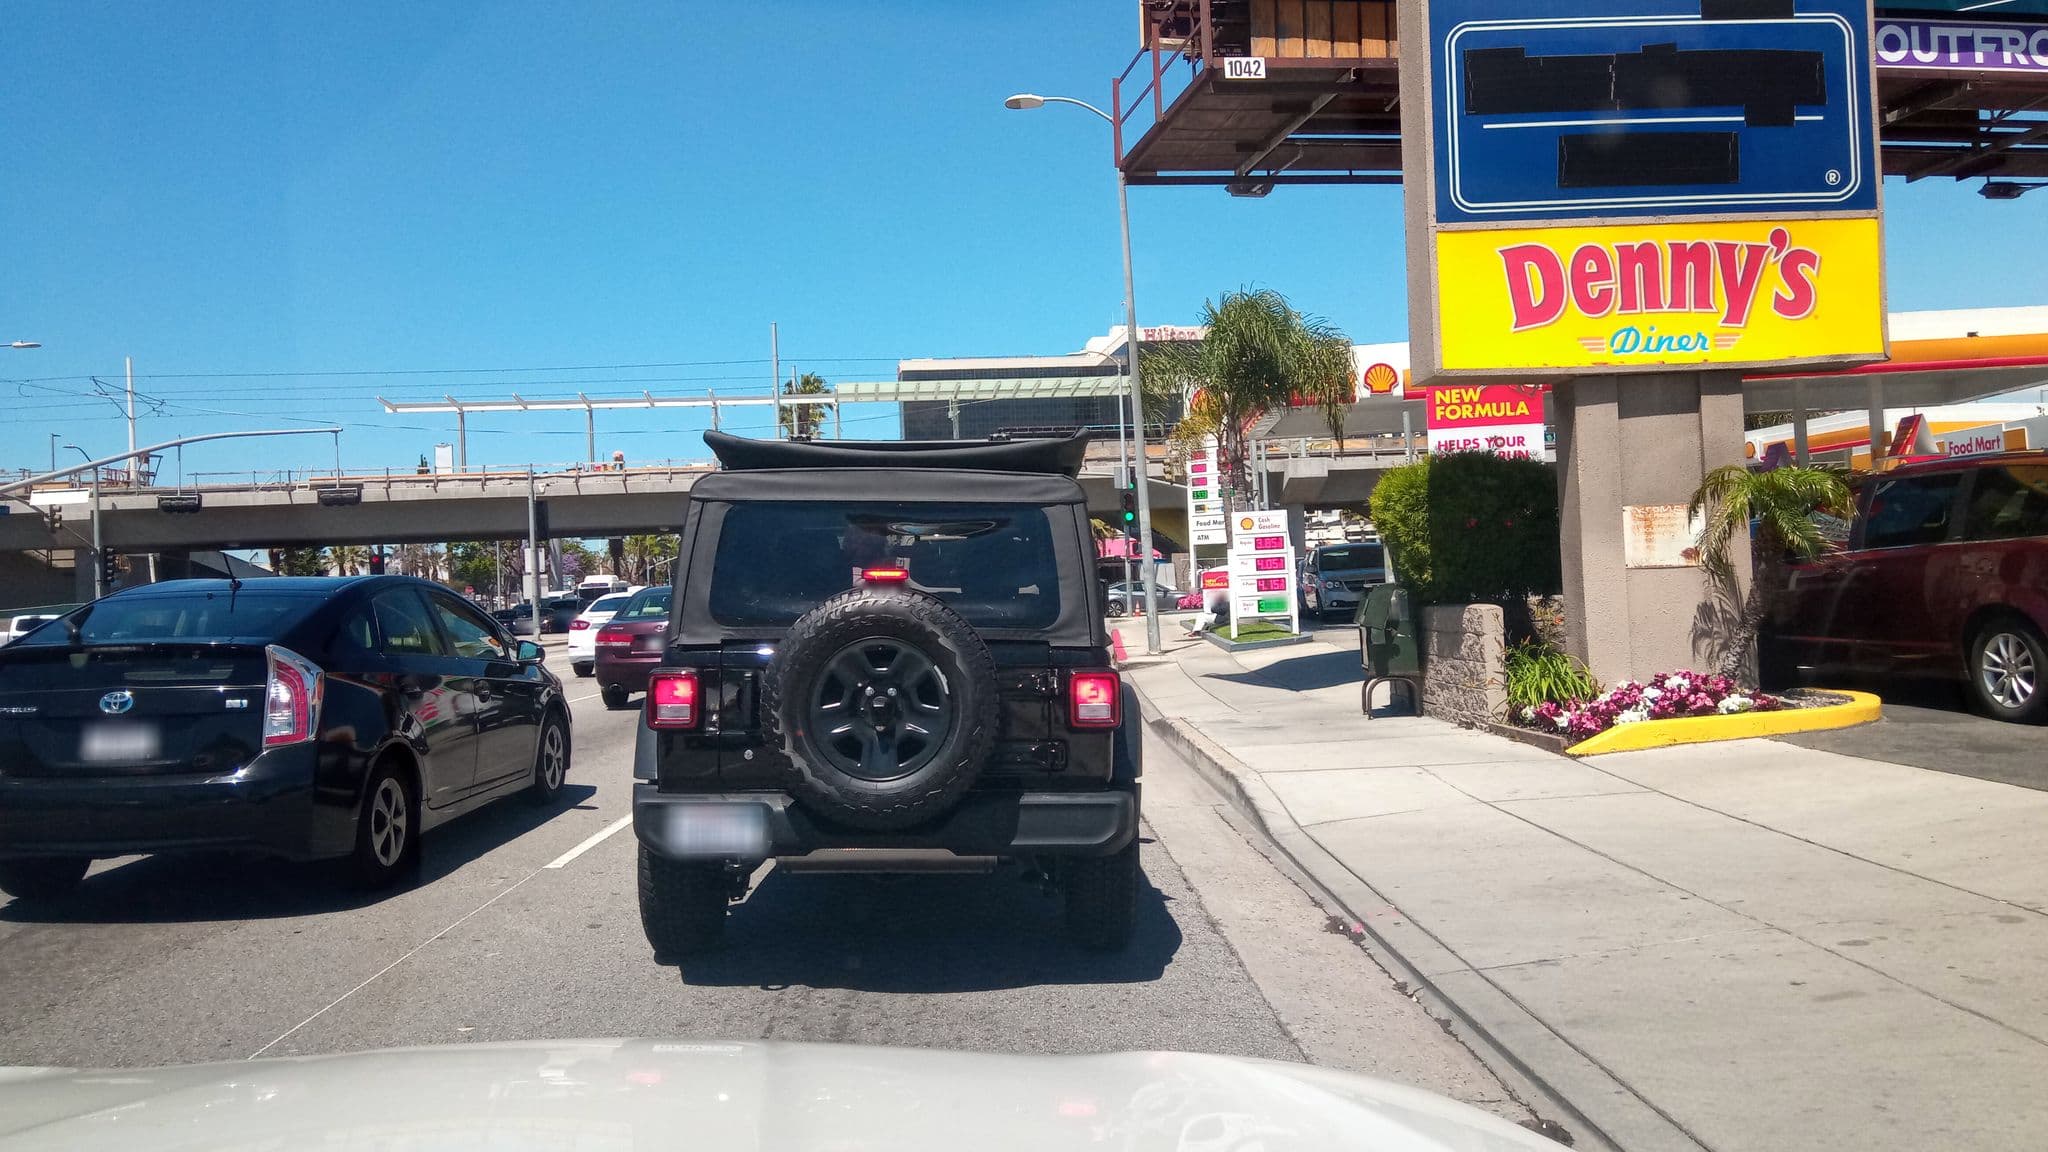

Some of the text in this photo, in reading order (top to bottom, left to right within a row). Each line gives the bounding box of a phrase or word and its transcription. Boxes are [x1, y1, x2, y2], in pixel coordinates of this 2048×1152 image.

[1227, 60, 1262, 77] 1042
[1498, 227, 1820, 333] Denny's
[1143, 327, 1197, 342] Hilton
[1608, 325, 1710, 355] Diner
[1434, 387, 1481, 405] NEW
[1435, 401, 1530, 421] FORMULA
[1437, 436, 1526, 451] HELPS YOUR
[1948, 435, 2001, 456] Food Mart
